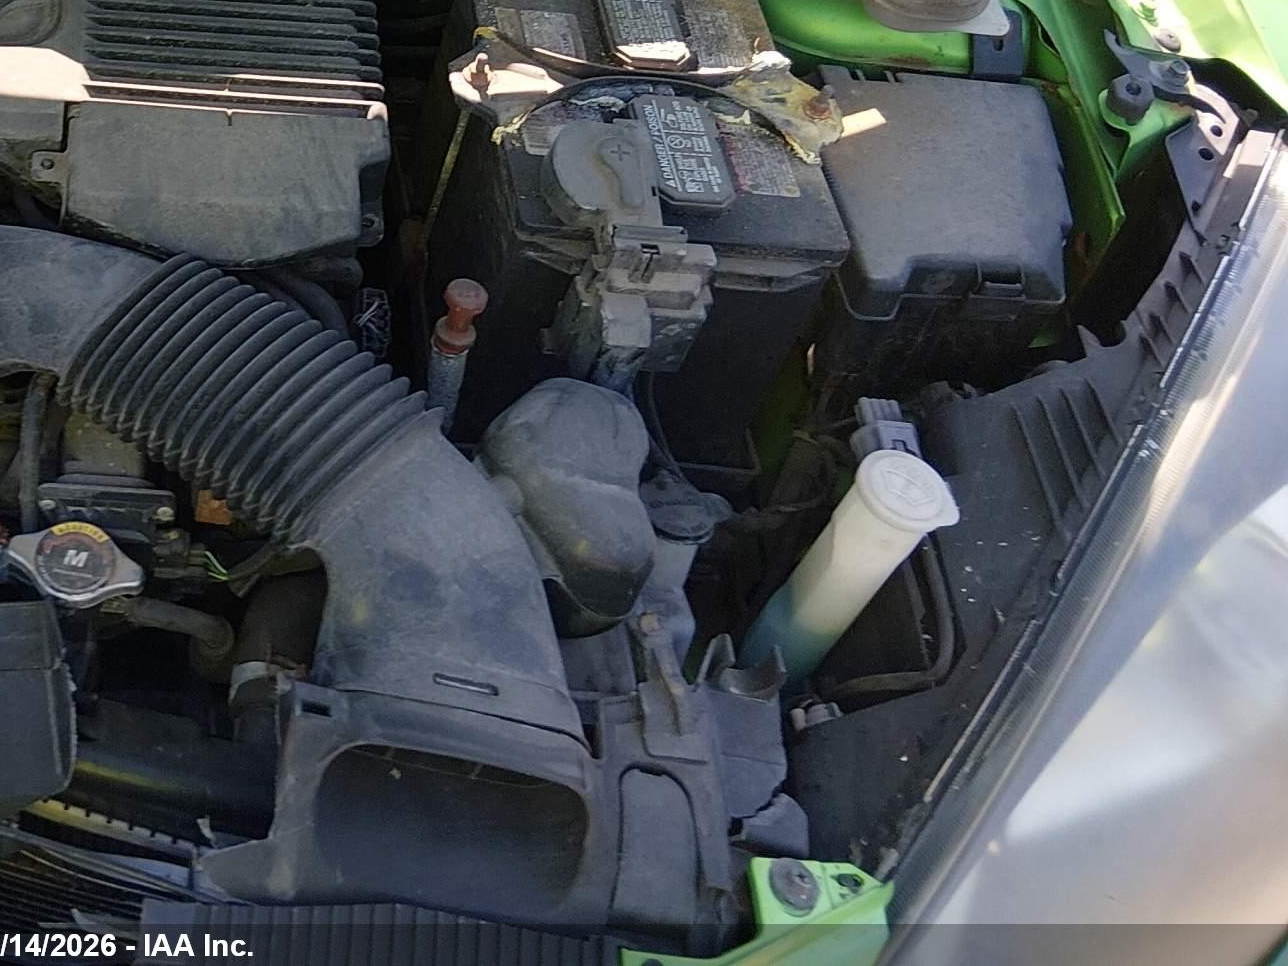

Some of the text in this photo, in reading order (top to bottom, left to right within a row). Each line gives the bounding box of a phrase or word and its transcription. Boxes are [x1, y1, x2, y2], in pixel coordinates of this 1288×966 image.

[643, 104, 661, 136] POISON
[654, 144, 675, 180] DANGER
[64, 549, 88, 567] M
